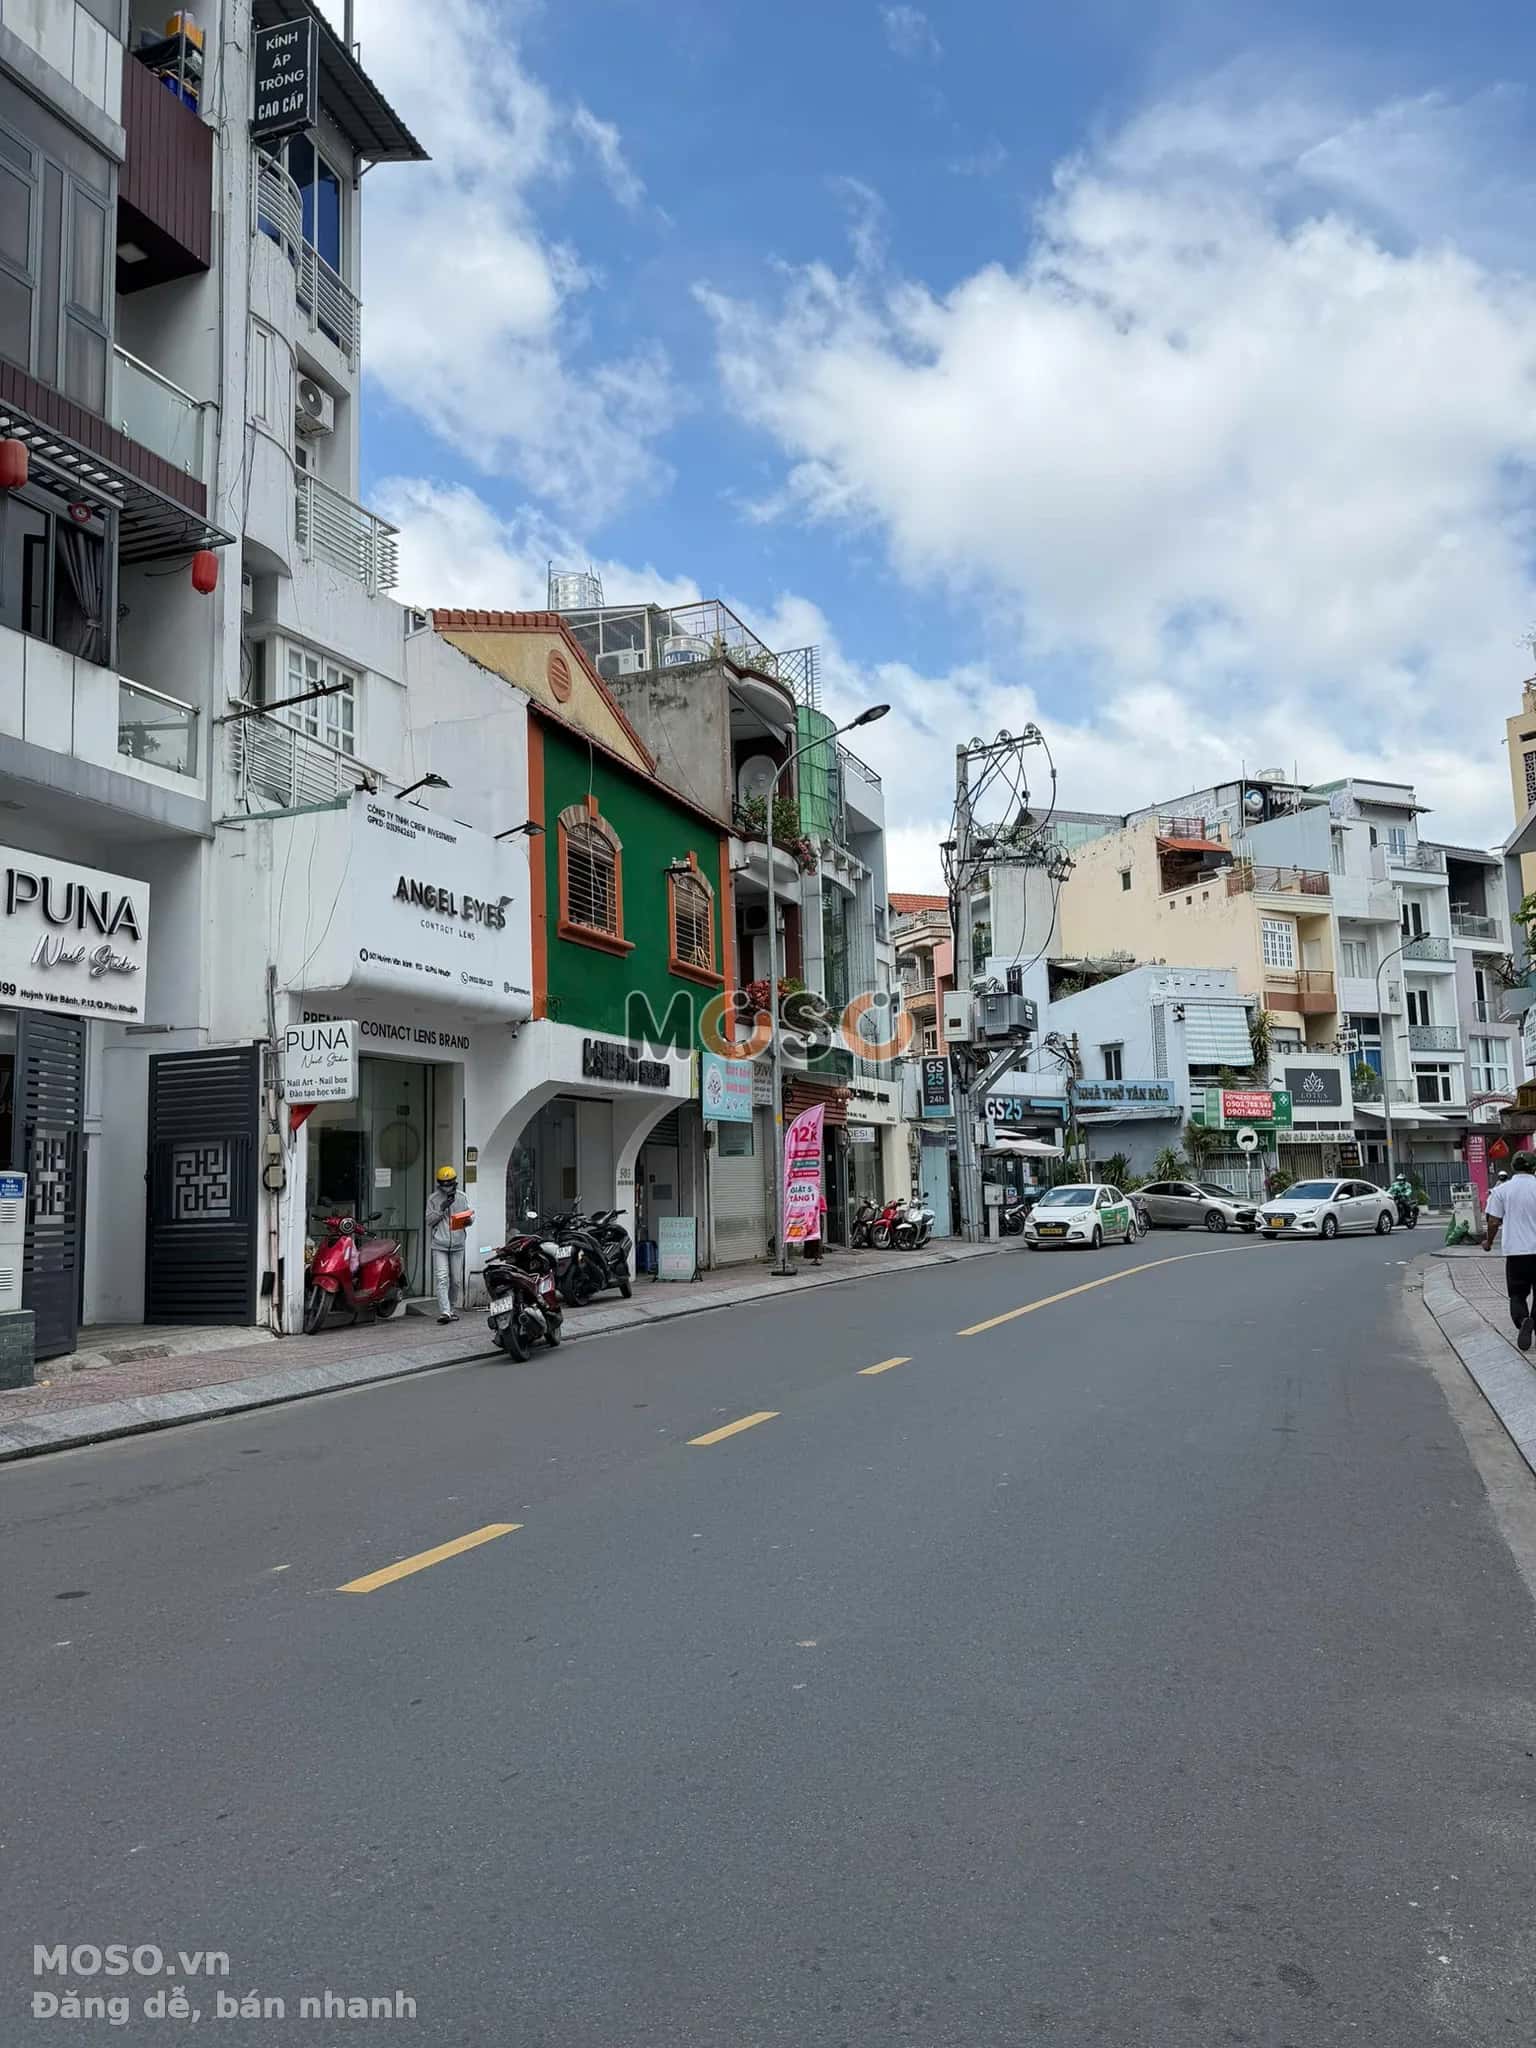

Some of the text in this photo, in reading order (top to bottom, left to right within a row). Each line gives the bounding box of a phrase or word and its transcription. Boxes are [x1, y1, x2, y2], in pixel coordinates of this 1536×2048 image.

[265, 31, 299, 51] KÍNH
[271, 53, 292, 69] ÁP
[259, 69, 305, 92] TRÒNG
[258, 90, 304, 121] CAO CẤP
[6, 868, 142, 941] PUNA
[392, 875, 506, 930] ANGEL EYES
[420, 919, 477, 942] CONTACT LENS
[31, 932, 141, 977] Nail Studio
[0, 981, 16, 996] 99
[20, 988, 43, 1001] Huỳnh
[45, 992, 59, 1003] Văn
[286, 1027, 349, 1053] PUNA
[360, 1020, 411, 1042] CONTACT
[413, 1028, 437, 1046] LENS
[439, 1032, 470, 1050] BRAND
[926, 1061, 945, 1073] GS
[287, 1079, 301, 1088] Nail
[302, 1078, 313, 1087] Art
[320, 1077, 334, 1086] Nail
[927, 1073, 945, 1086] 25
[289, 1089, 302, 1099] Đào
[316, 1087, 329, 1097] học
[928, 1095, 945, 1104] 24h
[984, 1097, 1024, 1121] GS25
